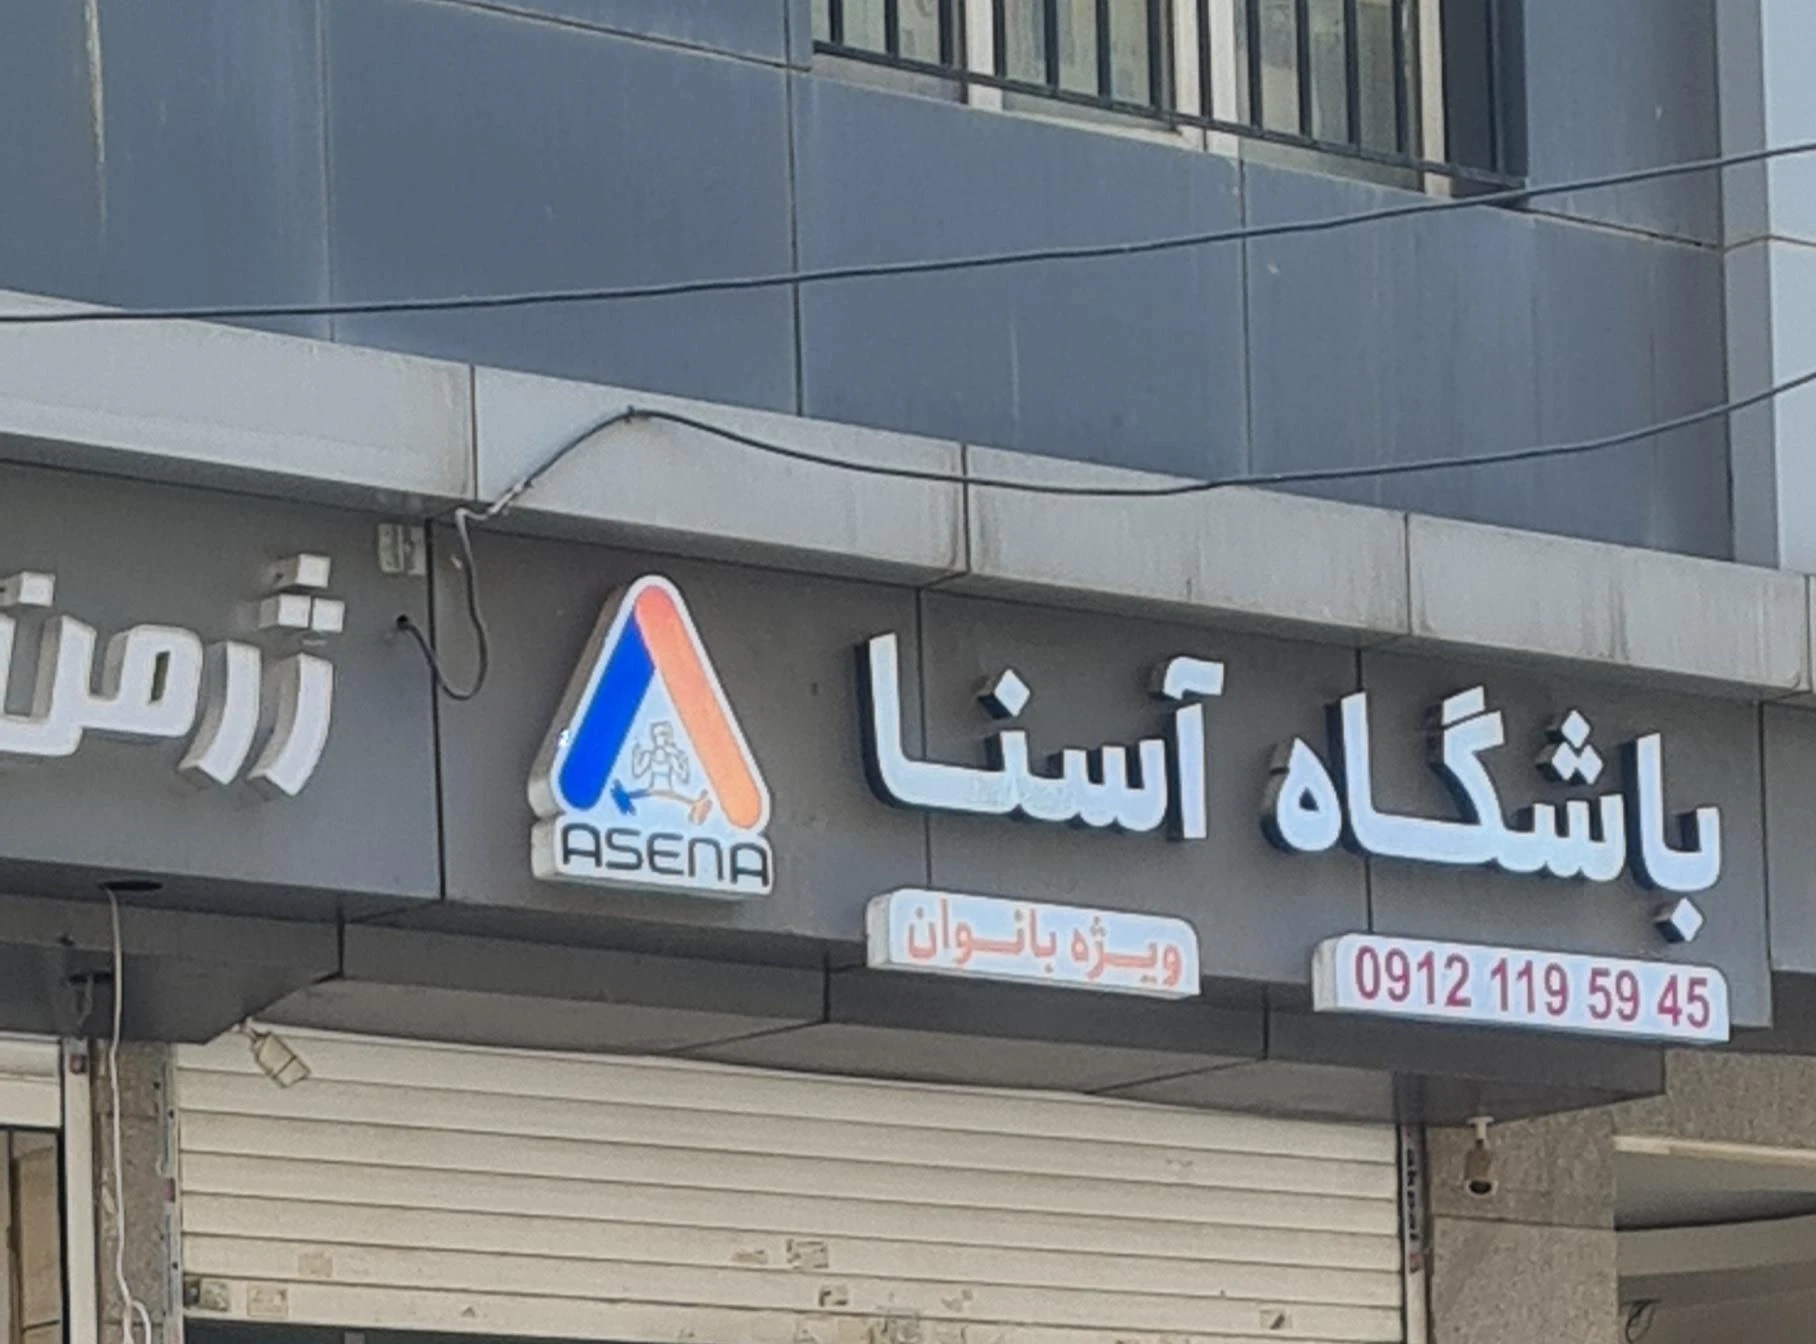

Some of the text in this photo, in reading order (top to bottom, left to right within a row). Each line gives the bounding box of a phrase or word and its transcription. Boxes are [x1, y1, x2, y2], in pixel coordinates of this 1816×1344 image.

[868, 632, 1720, 942] باشگاه آسنا
[561, 822, 770, 888] ASENA
[906, 898, 1182, 987] ویژه بانوان
[1355, 945, 1711, 1029] 0912 119 59 45
